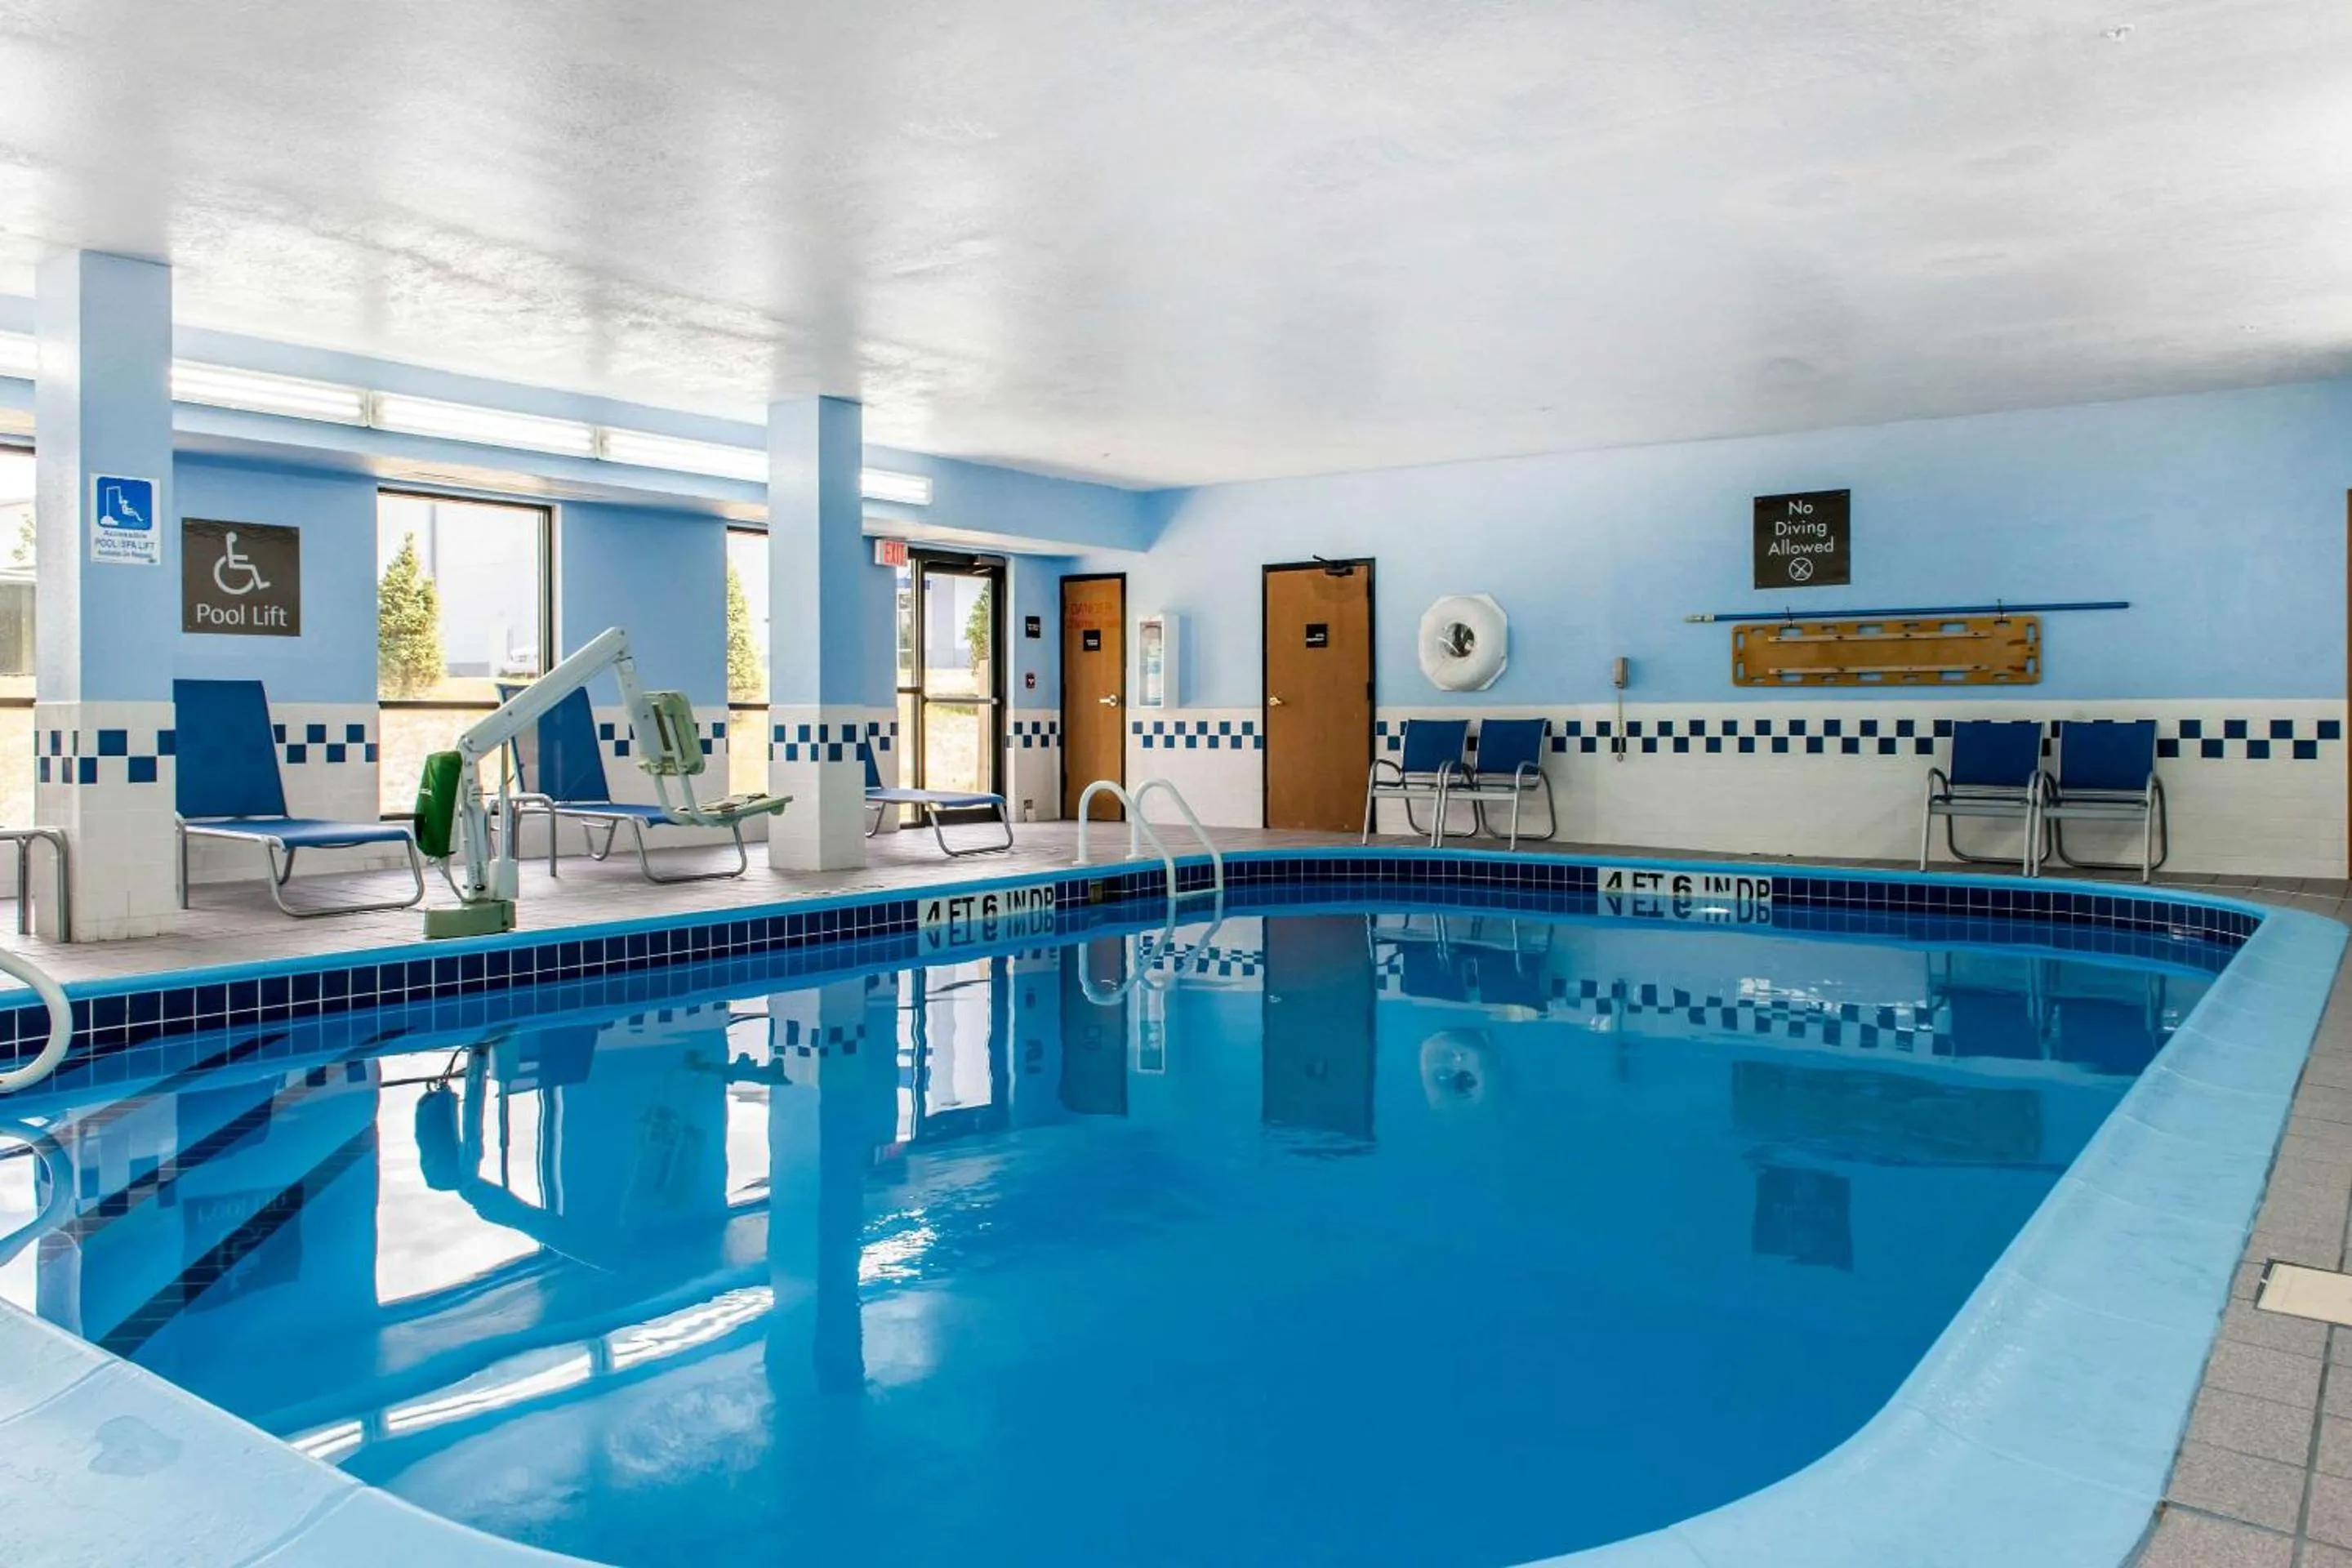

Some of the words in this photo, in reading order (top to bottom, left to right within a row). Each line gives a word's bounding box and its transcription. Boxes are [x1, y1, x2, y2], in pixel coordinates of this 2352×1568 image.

[1788, 499, 1814, 515] No
[1775, 519, 1828, 537] Diving
[884, 541, 906, 564] EXIT
[1767, 535, 1834, 556] Allowed
[196, 603, 245, 625] Pool
[252, 605, 288, 627] Lift
[1633, 872, 1664, 892] FT
[1672, 874, 1693, 897] 6
[1704, 875, 1731, 893] IN
[1736, 877, 1771, 901] DP
[948, 896, 976, 923] FT
[982, 894, 998, 916] 6
[1005, 889, 1027, 911] IN
[1029, 887, 1055, 909] DP
